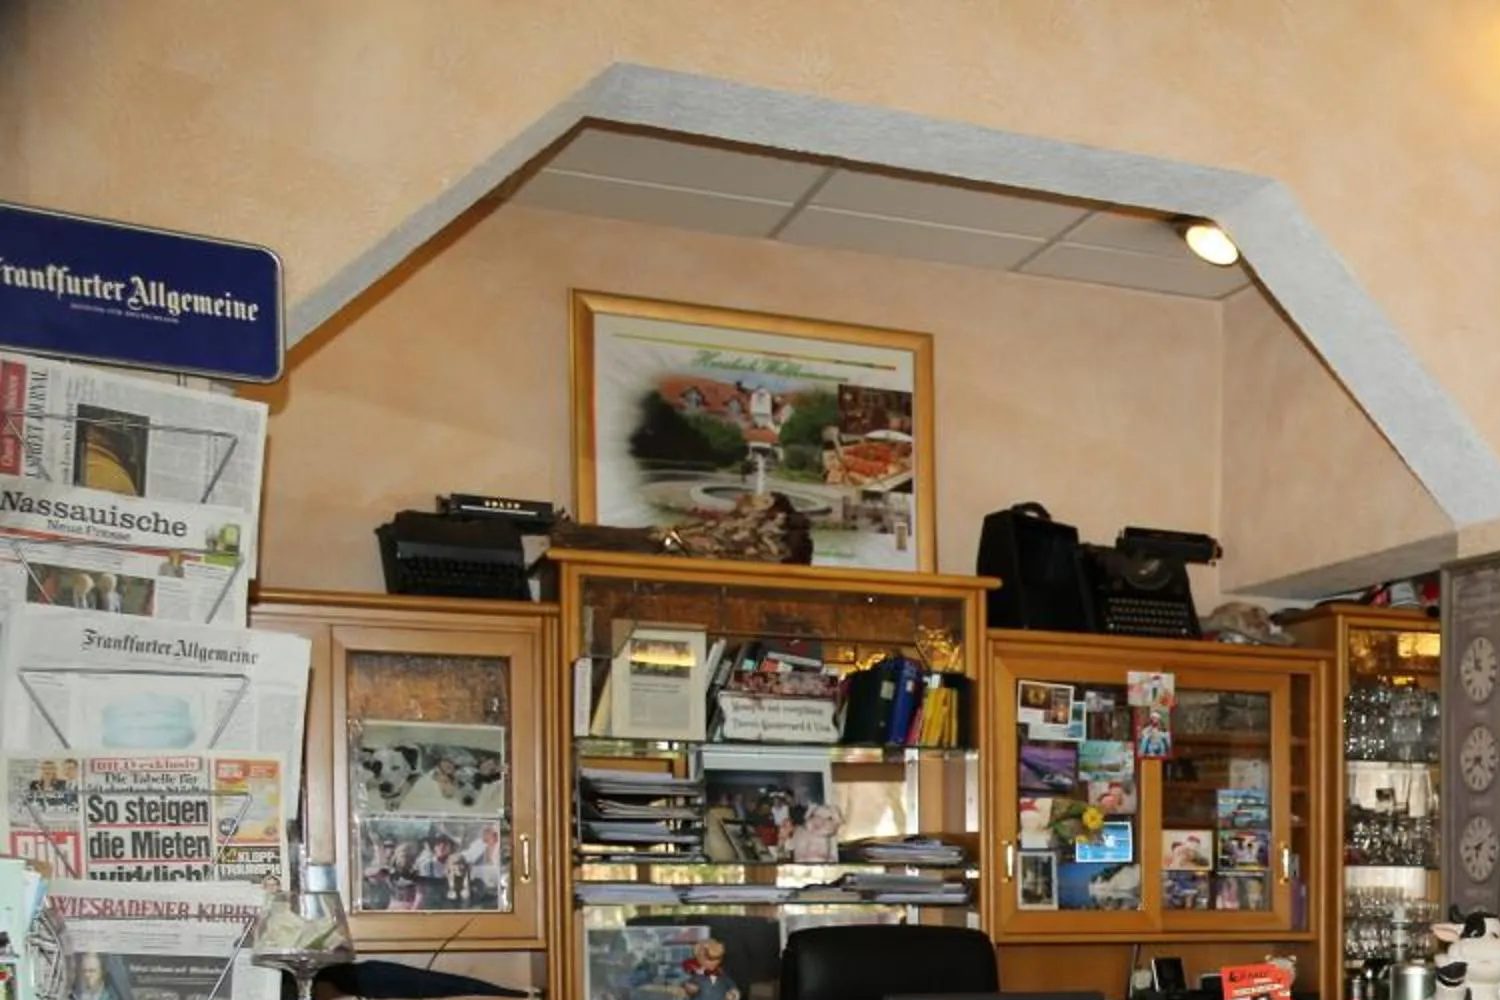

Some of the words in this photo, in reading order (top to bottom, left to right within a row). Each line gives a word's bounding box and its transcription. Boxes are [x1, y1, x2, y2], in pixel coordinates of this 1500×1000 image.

[0, 257, 125, 300] rankfurter
[127, 275, 259, 322] Allgemeine
[0, 490, 188, 538] Nassauische
[82, 627, 174, 656] Frankfurter
[174, 638, 260, 666] Allgemeine
[88, 794, 118, 823] So
[125, 795, 208, 826] steigen
[89, 831, 125, 859] die
[131, 831, 211, 859] Mieten
[50, 896, 189, 922] WIESBADENER
